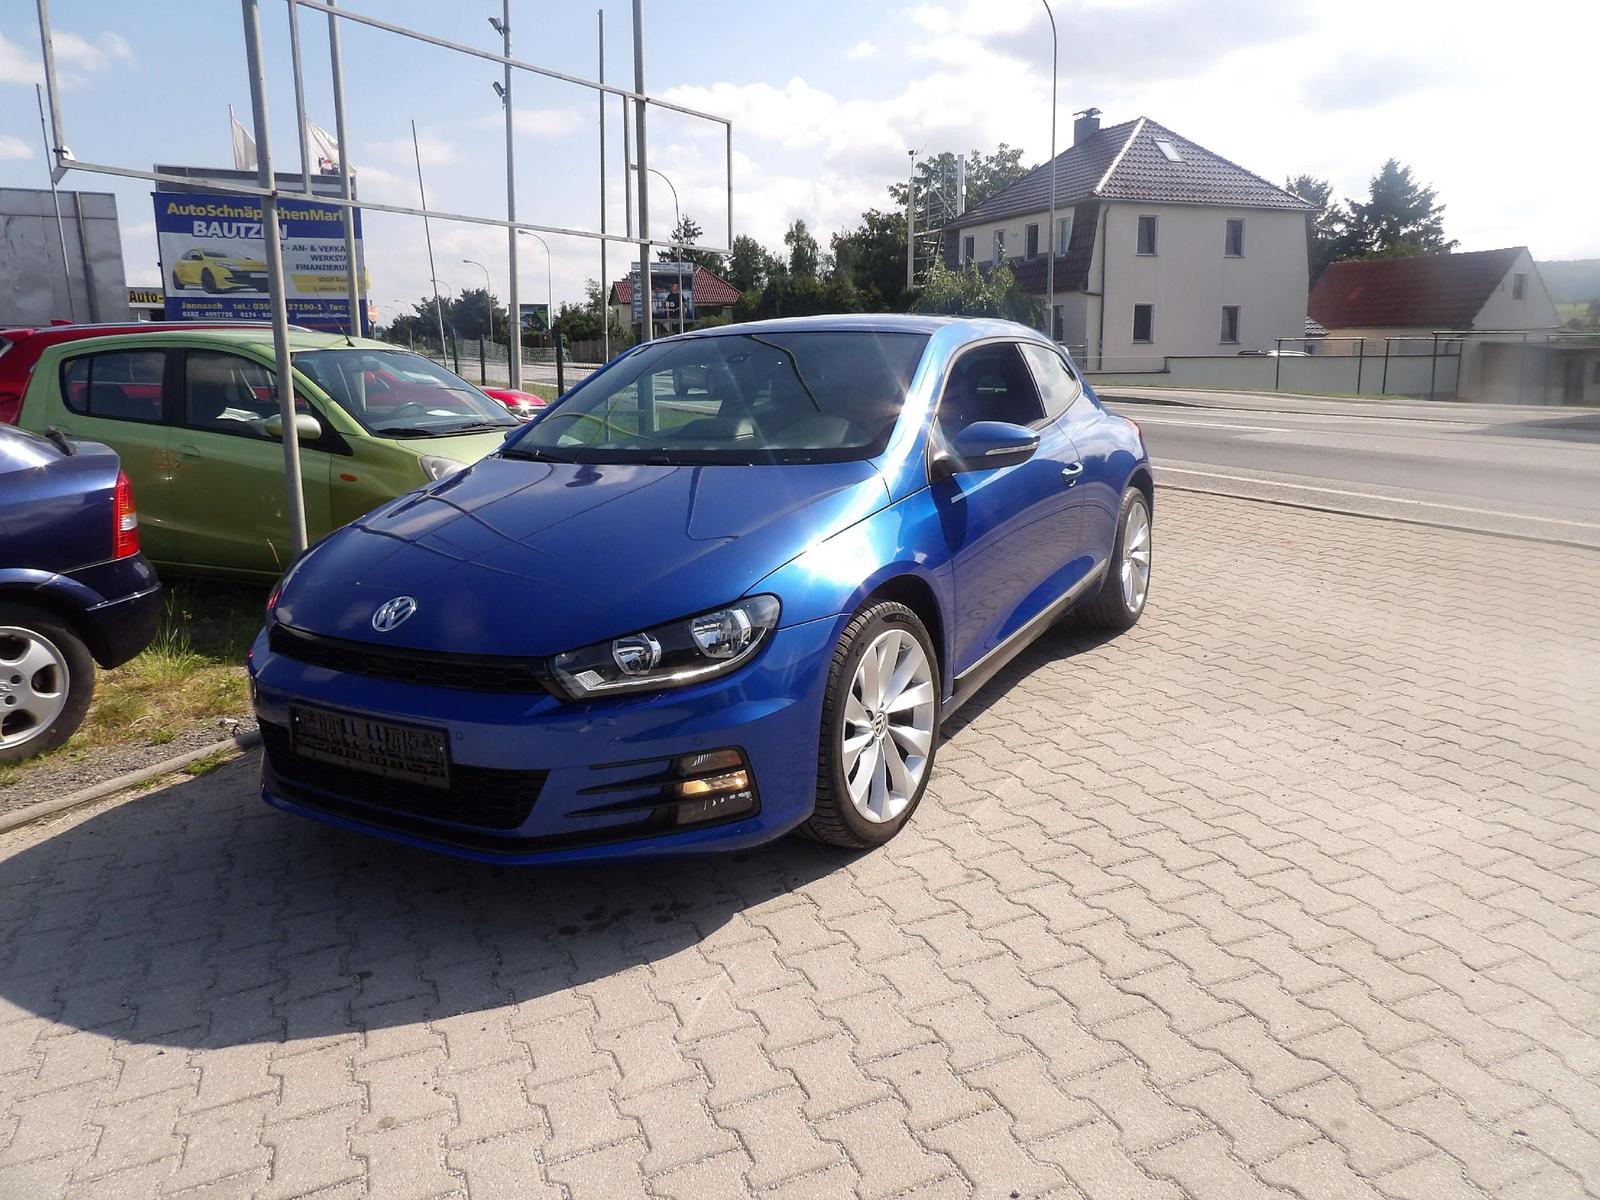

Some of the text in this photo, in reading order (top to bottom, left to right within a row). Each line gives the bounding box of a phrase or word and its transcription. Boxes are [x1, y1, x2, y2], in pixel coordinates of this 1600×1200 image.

[167, 202, 344, 221] AutoSchnäphenMar
[193, 220, 289, 240] BAUTZN
[319, 245, 346, 253] VERKA
[296, 263, 347, 271] FINANZIERU
